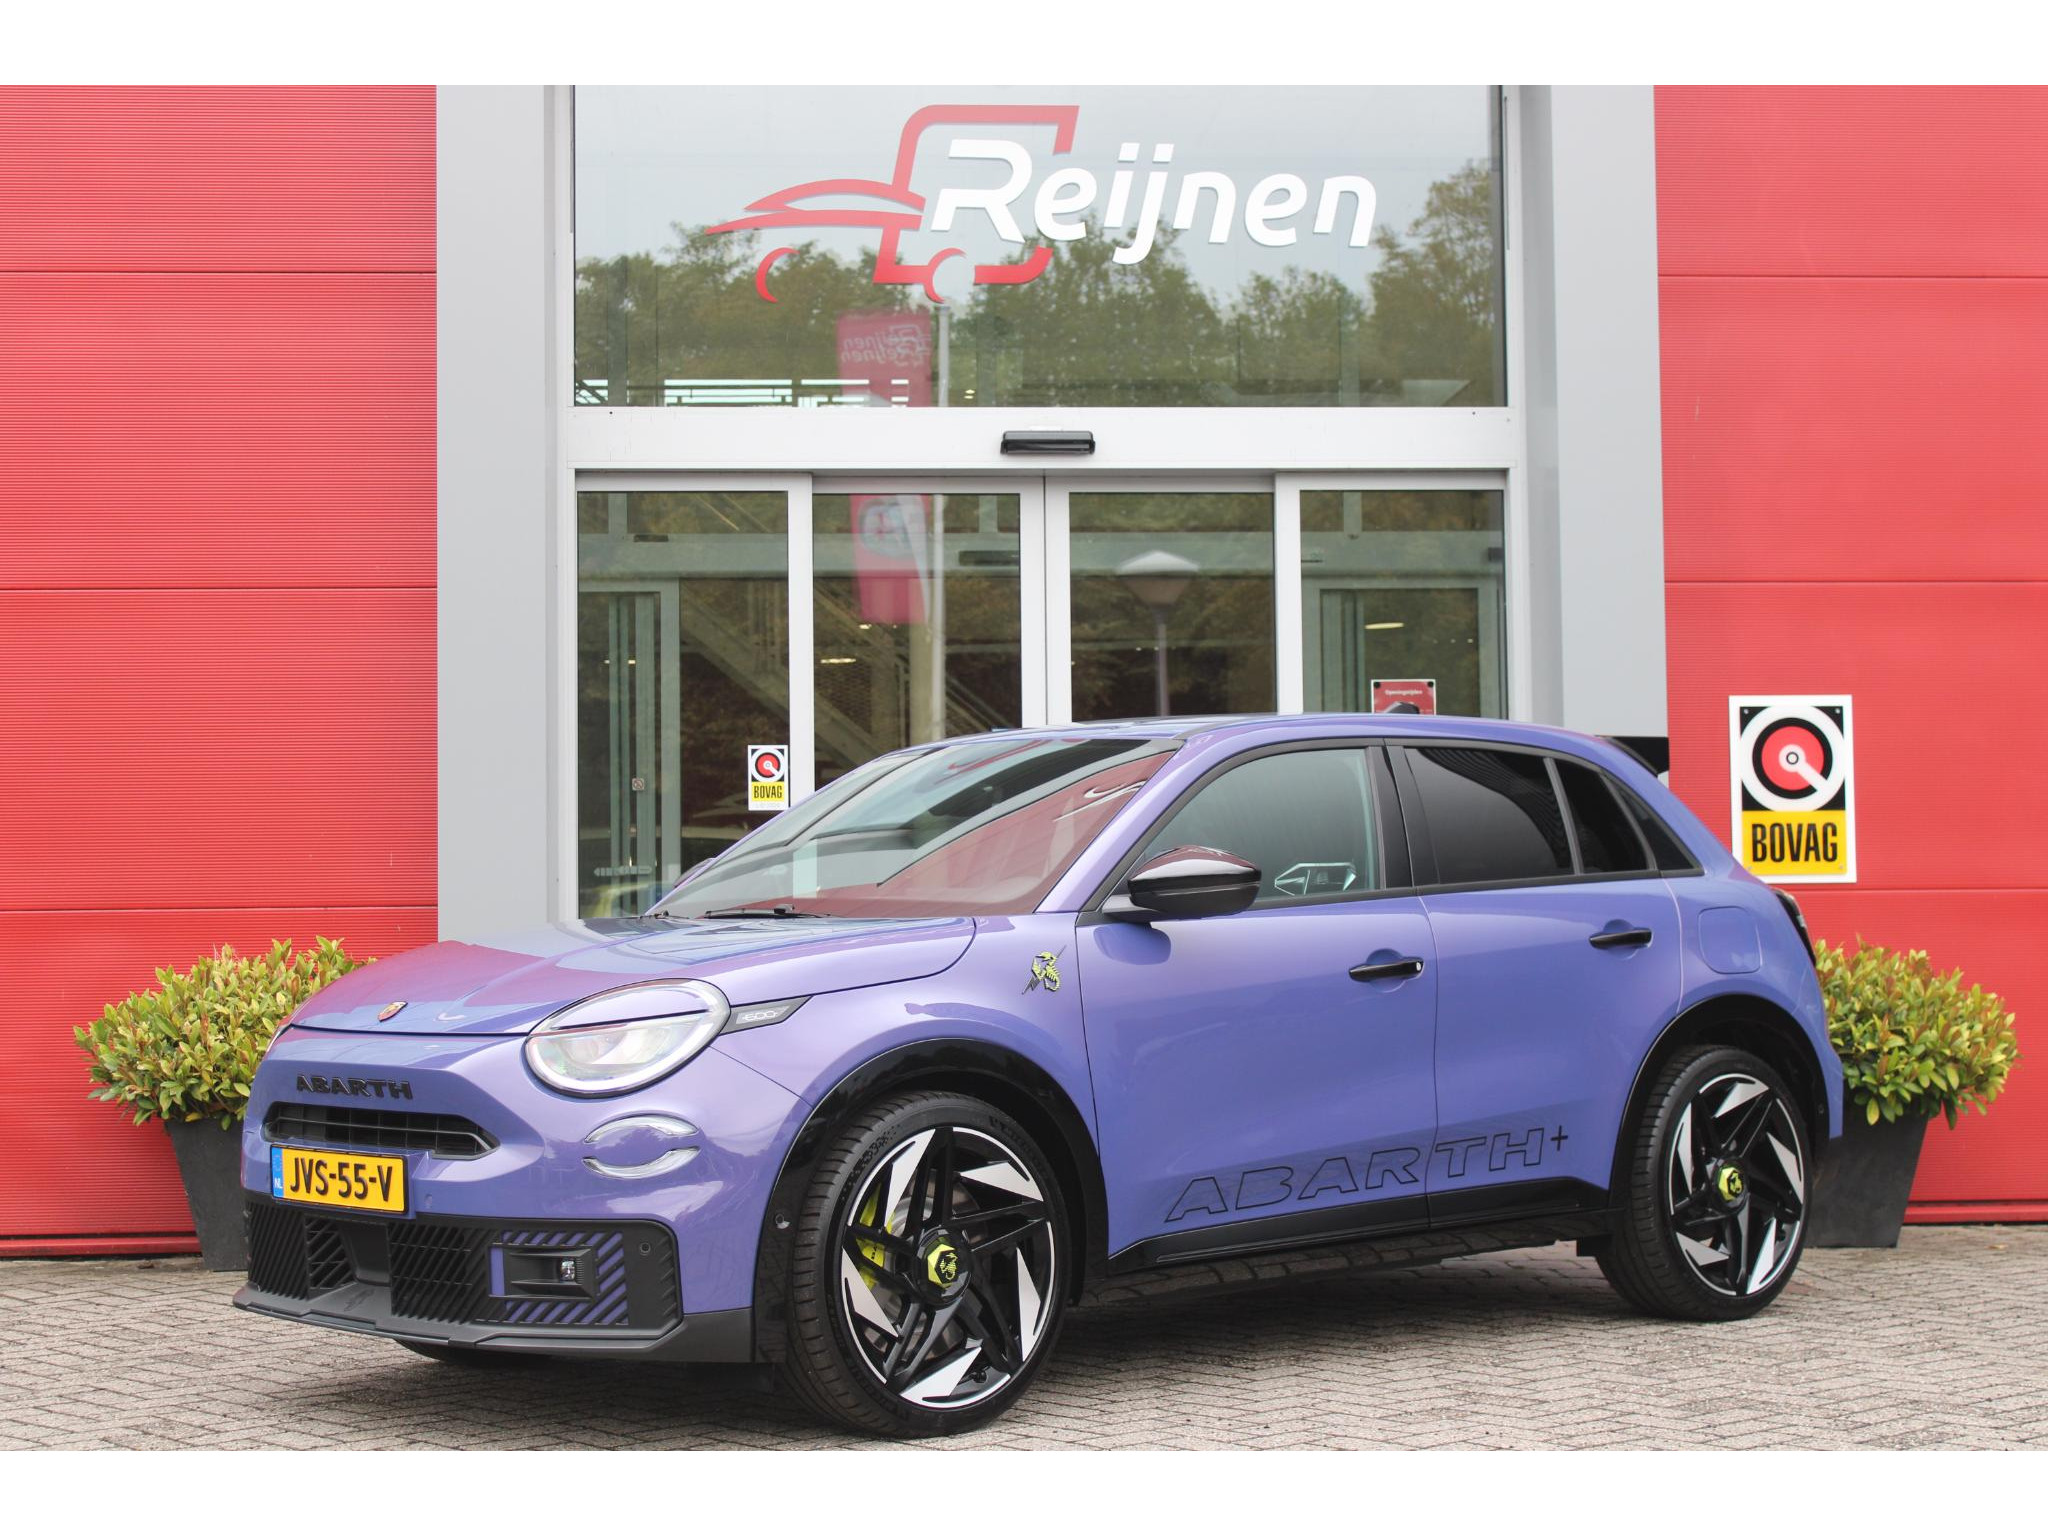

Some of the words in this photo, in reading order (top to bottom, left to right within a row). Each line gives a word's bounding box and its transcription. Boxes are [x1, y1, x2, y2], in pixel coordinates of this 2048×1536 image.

[930, 139, 1377, 265] Reijnen
[754, 785, 783, 798] BOVAG
[1752, 822, 1838, 863] BOVAG
[296, 1073, 413, 1100] ABARTH
[274, 1178, 283, 1189] NL
[290, 1157, 393, 1202] JVS-55-V
